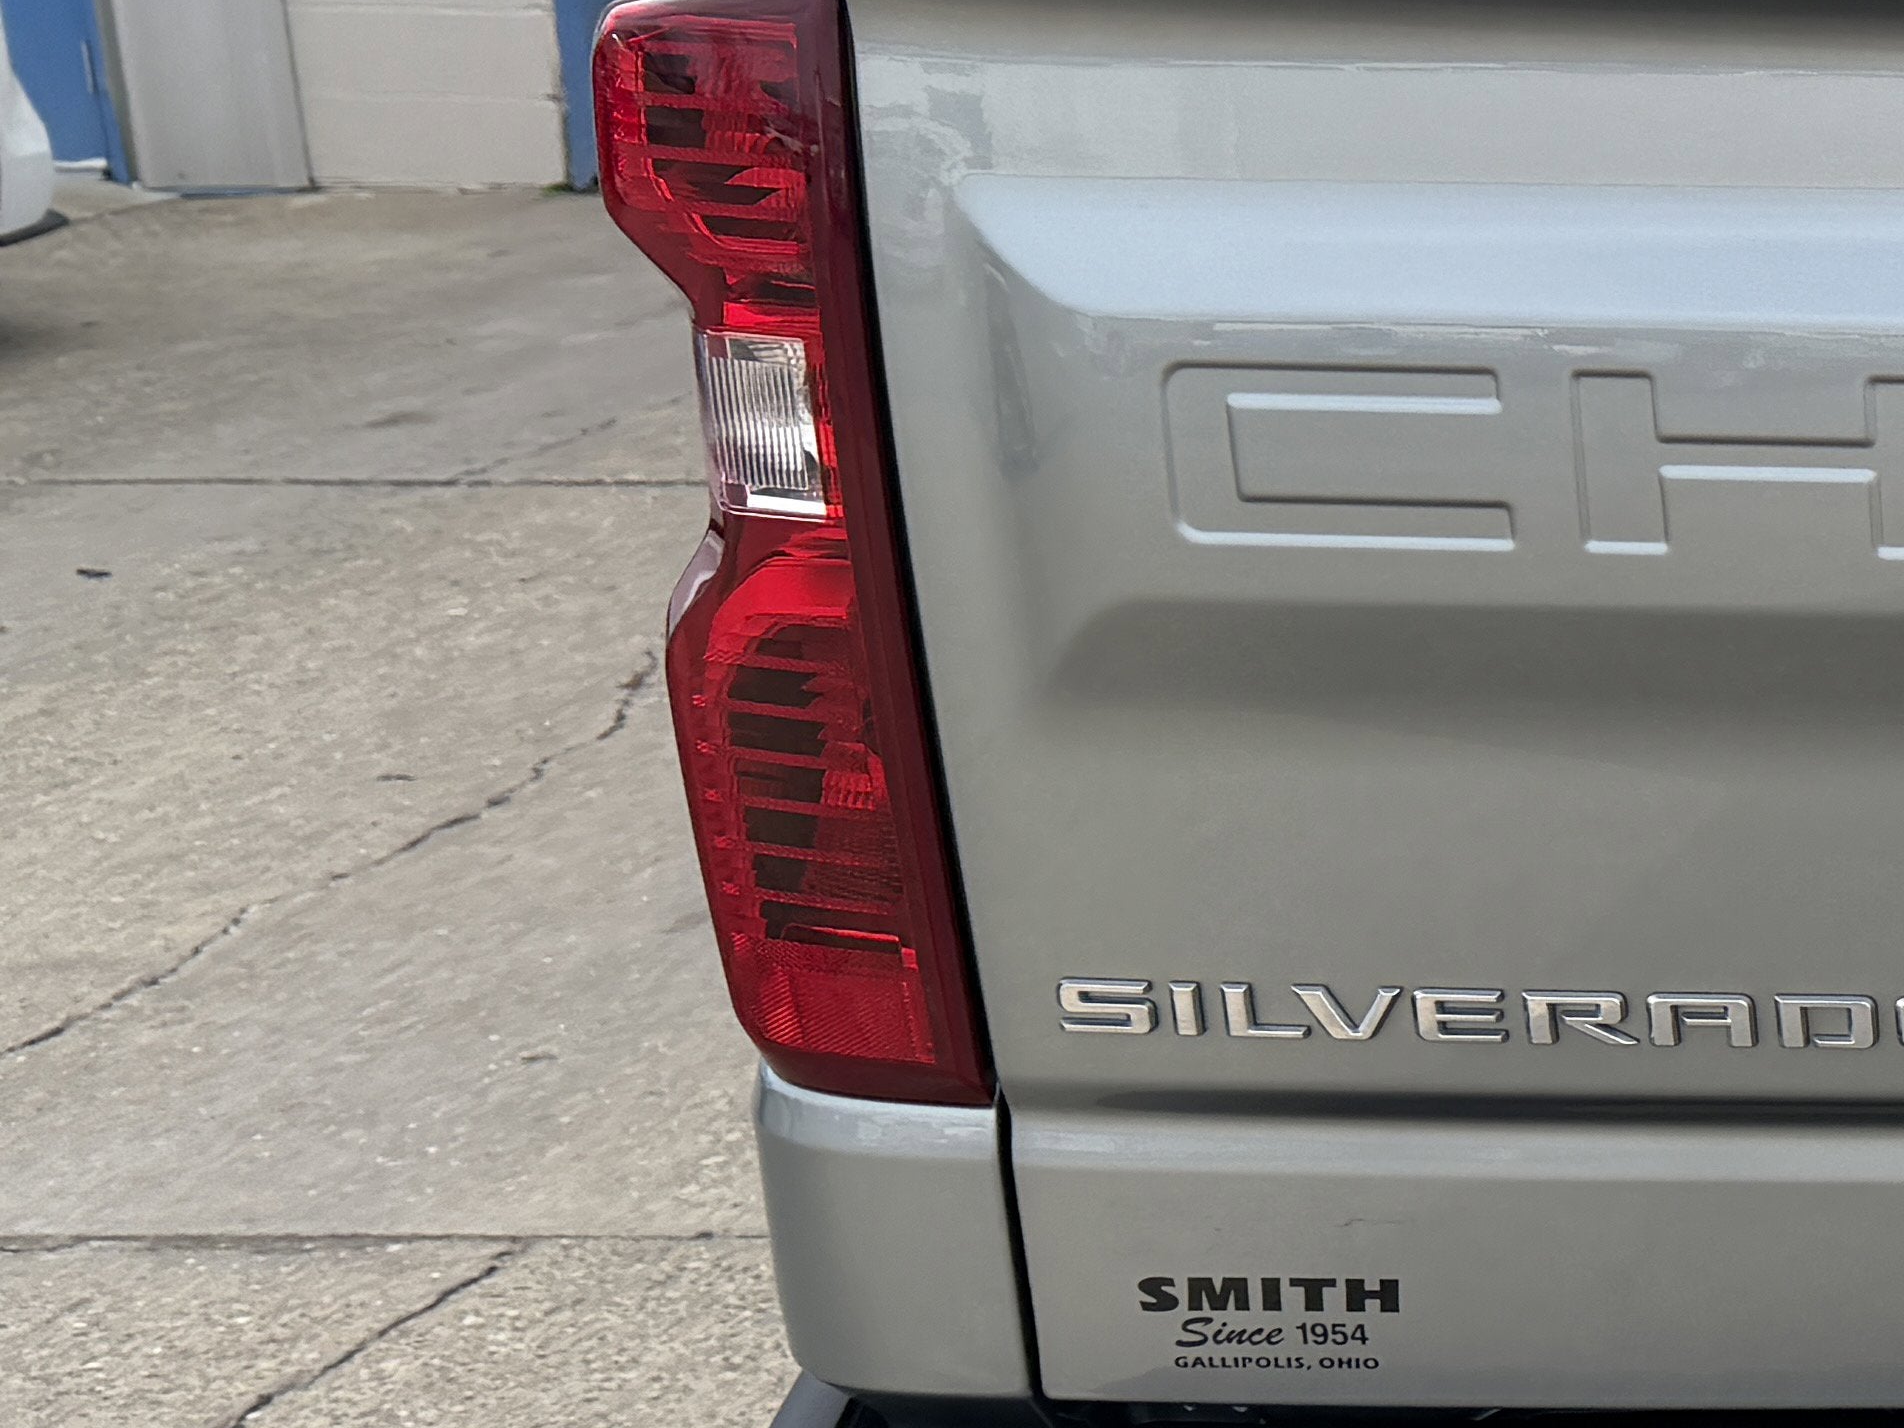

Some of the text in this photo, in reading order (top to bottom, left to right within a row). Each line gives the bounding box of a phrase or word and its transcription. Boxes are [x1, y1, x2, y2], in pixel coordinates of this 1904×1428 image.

[1137, 1276, 1400, 1313] SMITH
[1175, 1317, 1370, 1348] Since 1954
[1174, 1355, 1380, 1371] GALLIPOLIS, OHIO
